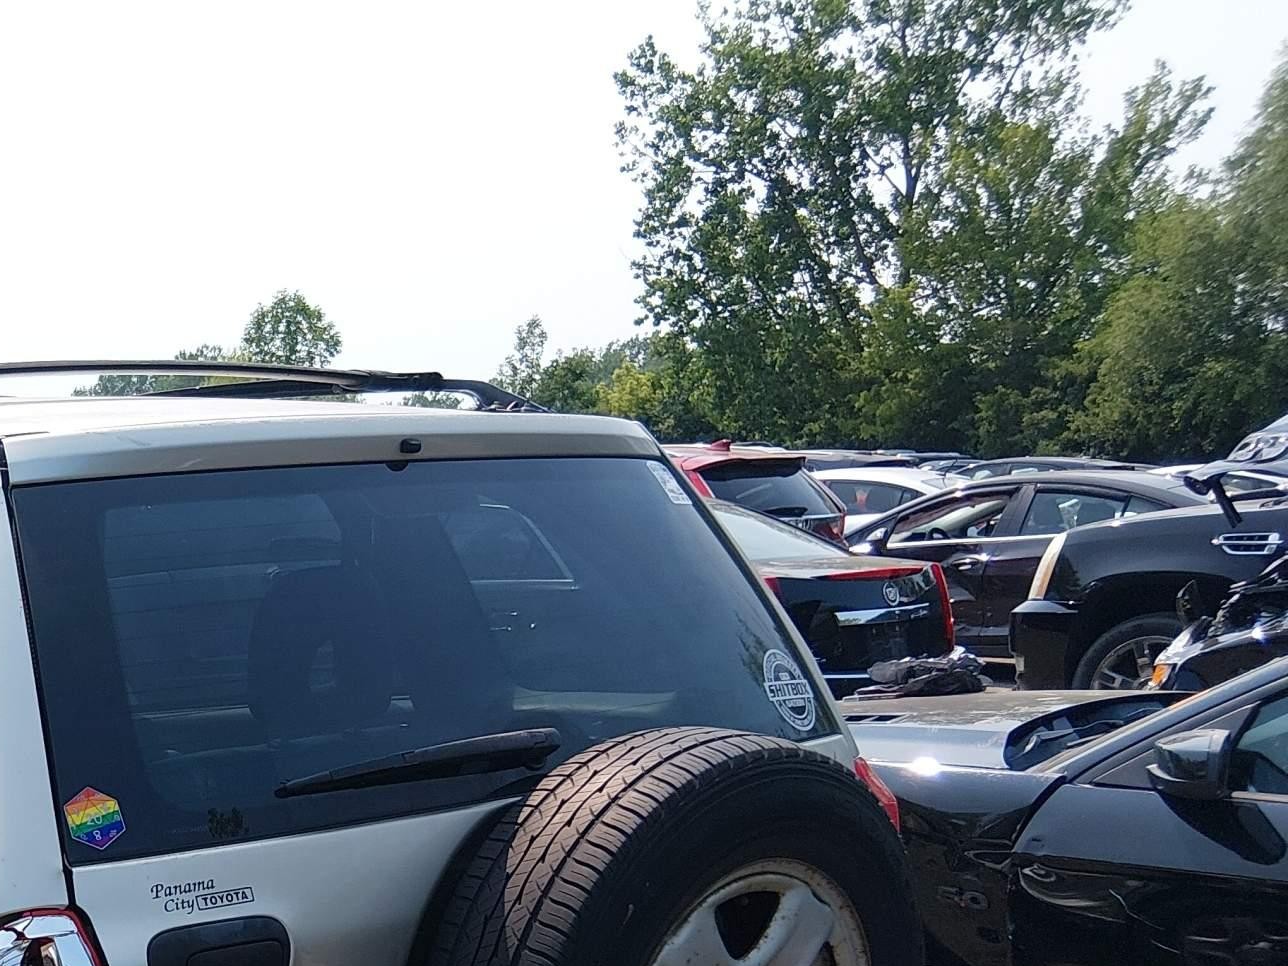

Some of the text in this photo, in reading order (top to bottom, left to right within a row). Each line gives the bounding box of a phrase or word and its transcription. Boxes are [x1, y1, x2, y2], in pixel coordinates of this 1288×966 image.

[768, 682, 810, 698] SHITBOX
[150, 879, 216, 900] Panama
[164, 890, 249, 915] City TOYOTA
